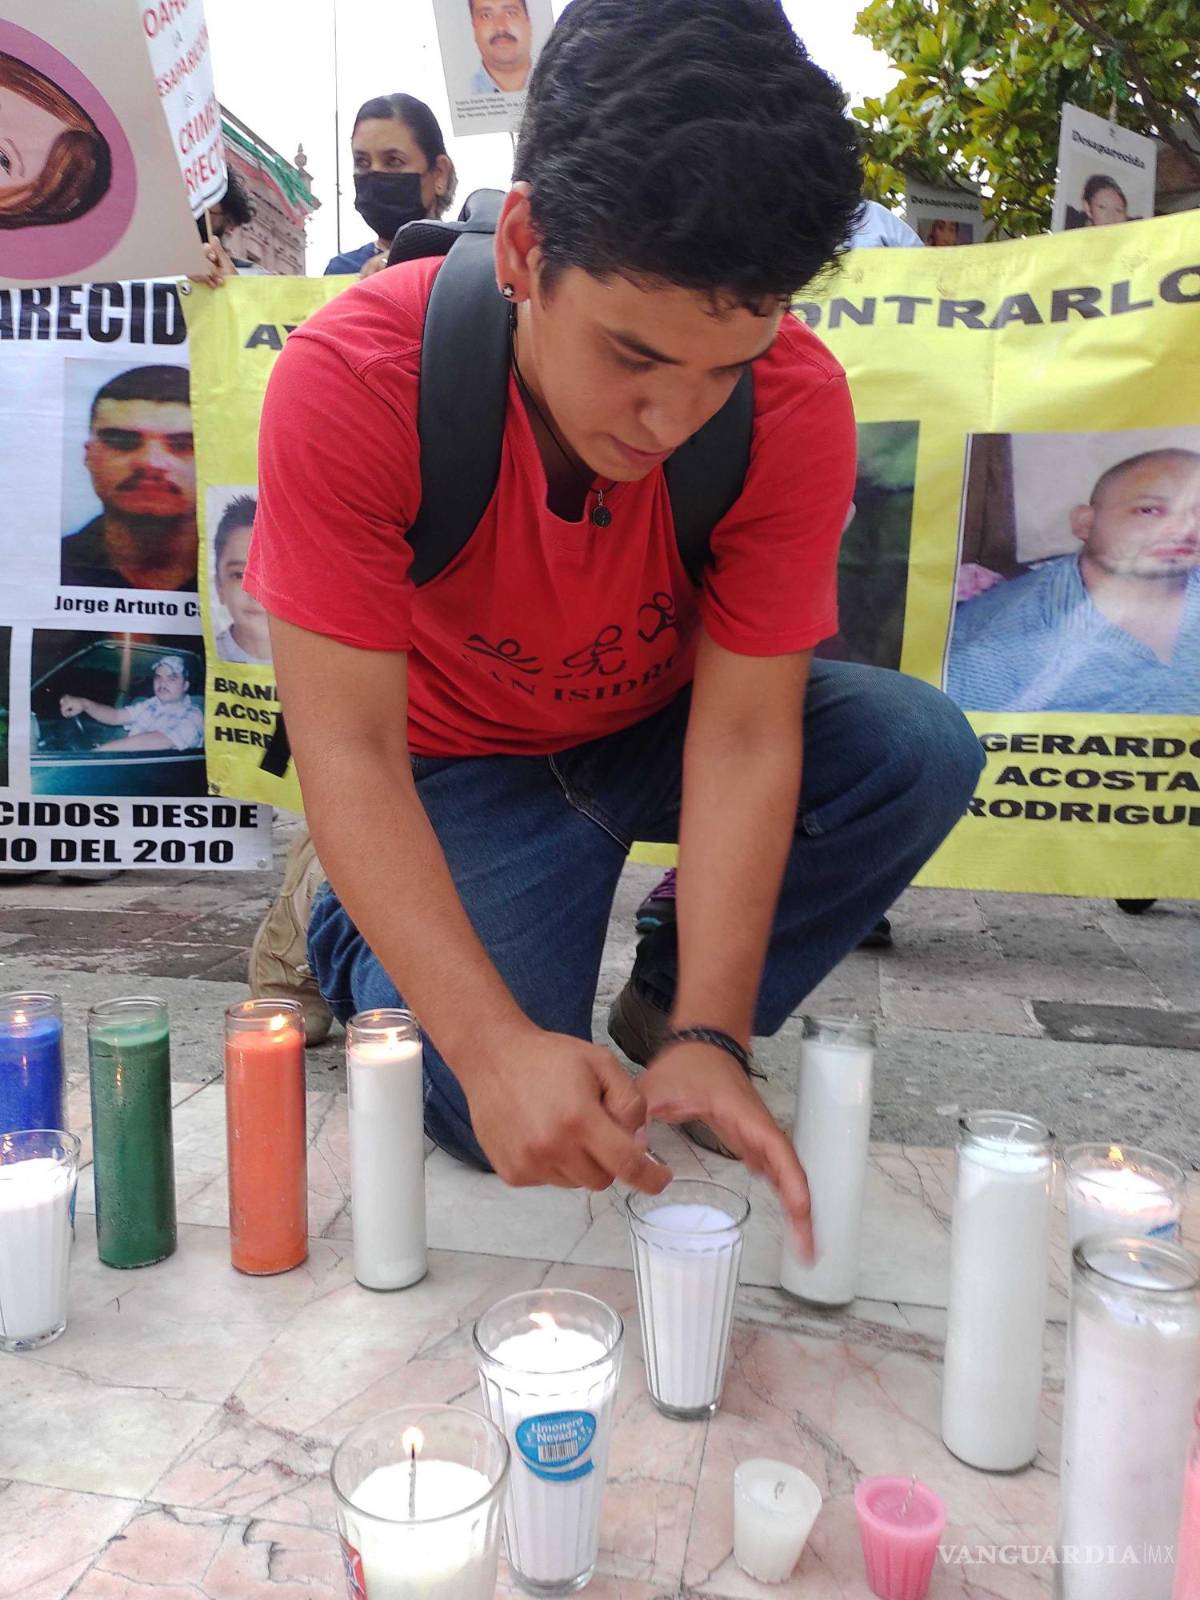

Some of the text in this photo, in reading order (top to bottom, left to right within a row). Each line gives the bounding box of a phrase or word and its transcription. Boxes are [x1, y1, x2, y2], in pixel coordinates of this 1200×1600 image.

[54, 596, 109, 614] Jorge
[114, 598, 178, 616] Artuto
[994, 766, 1200, 792] ACOSTA
[132, 804, 258, 828] DESDE
[50, 839, 122, 862] DEL
[133, 839, 234, 863] 2010
